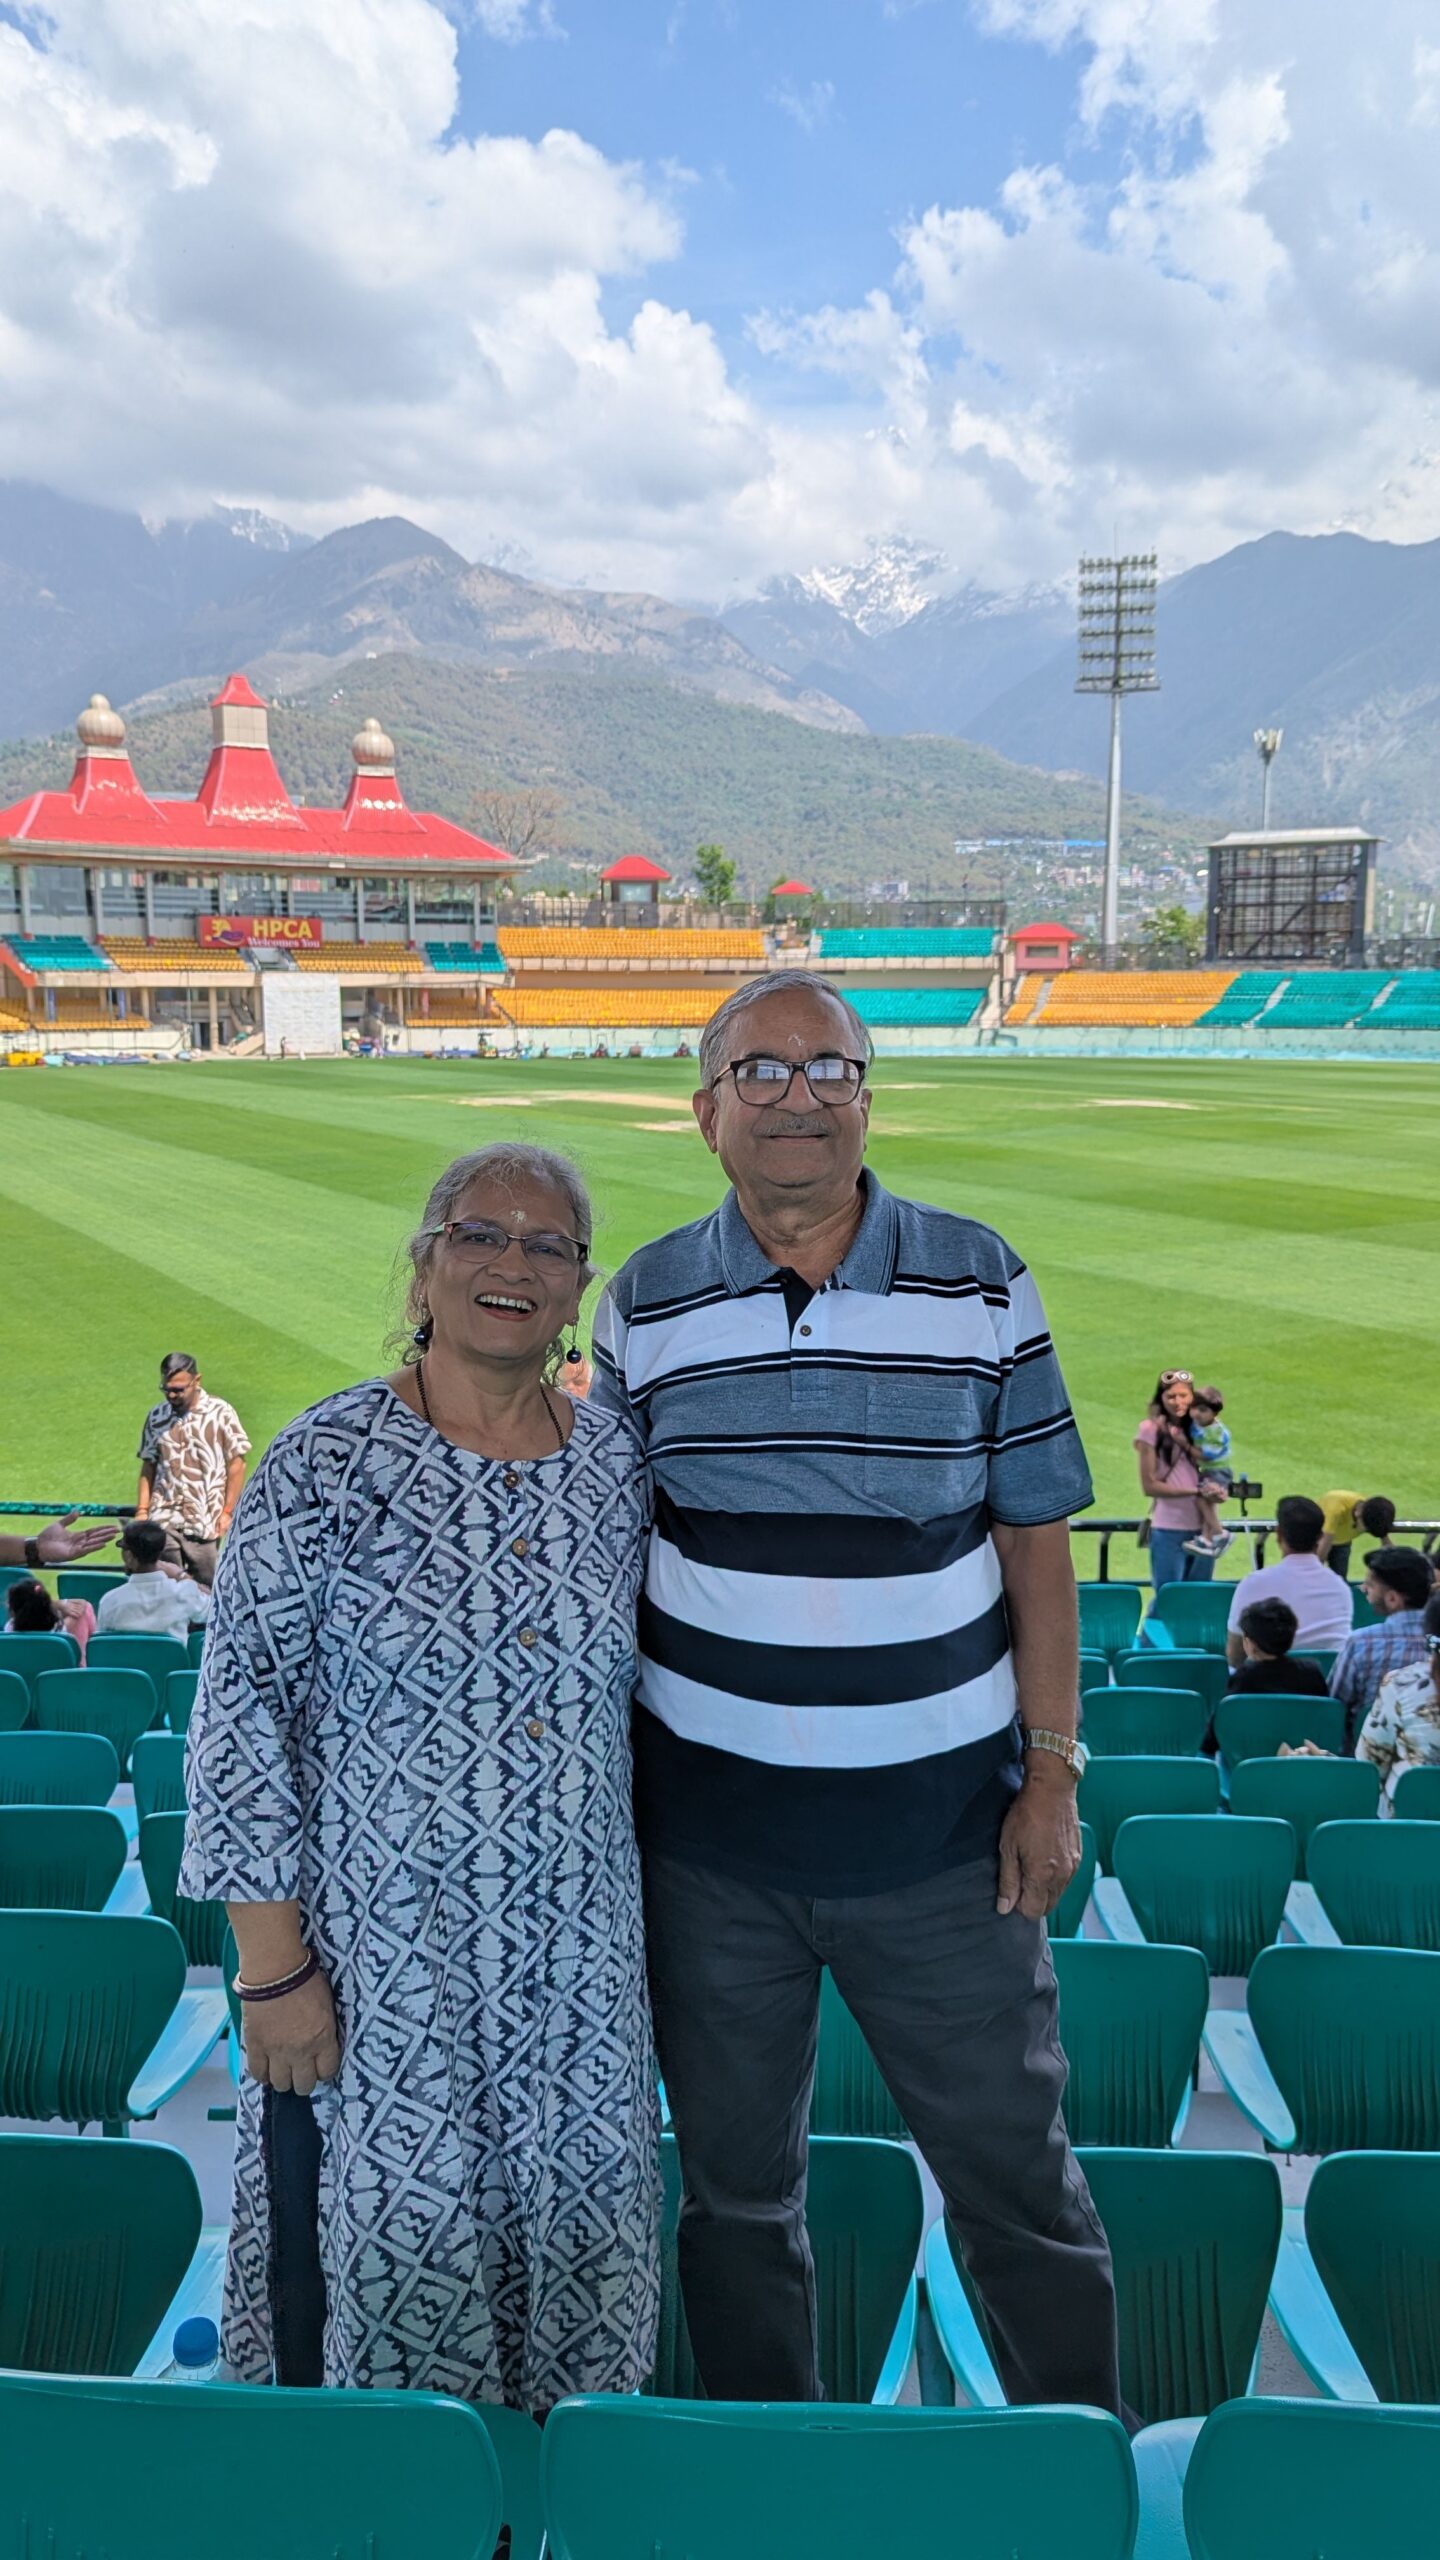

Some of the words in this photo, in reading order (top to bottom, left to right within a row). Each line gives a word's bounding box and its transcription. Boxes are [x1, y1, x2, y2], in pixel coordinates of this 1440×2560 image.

[253, 919, 312, 938] HPCA
[247, 937, 299, 947] Welcomes
[301, 939, 320, 948] You
